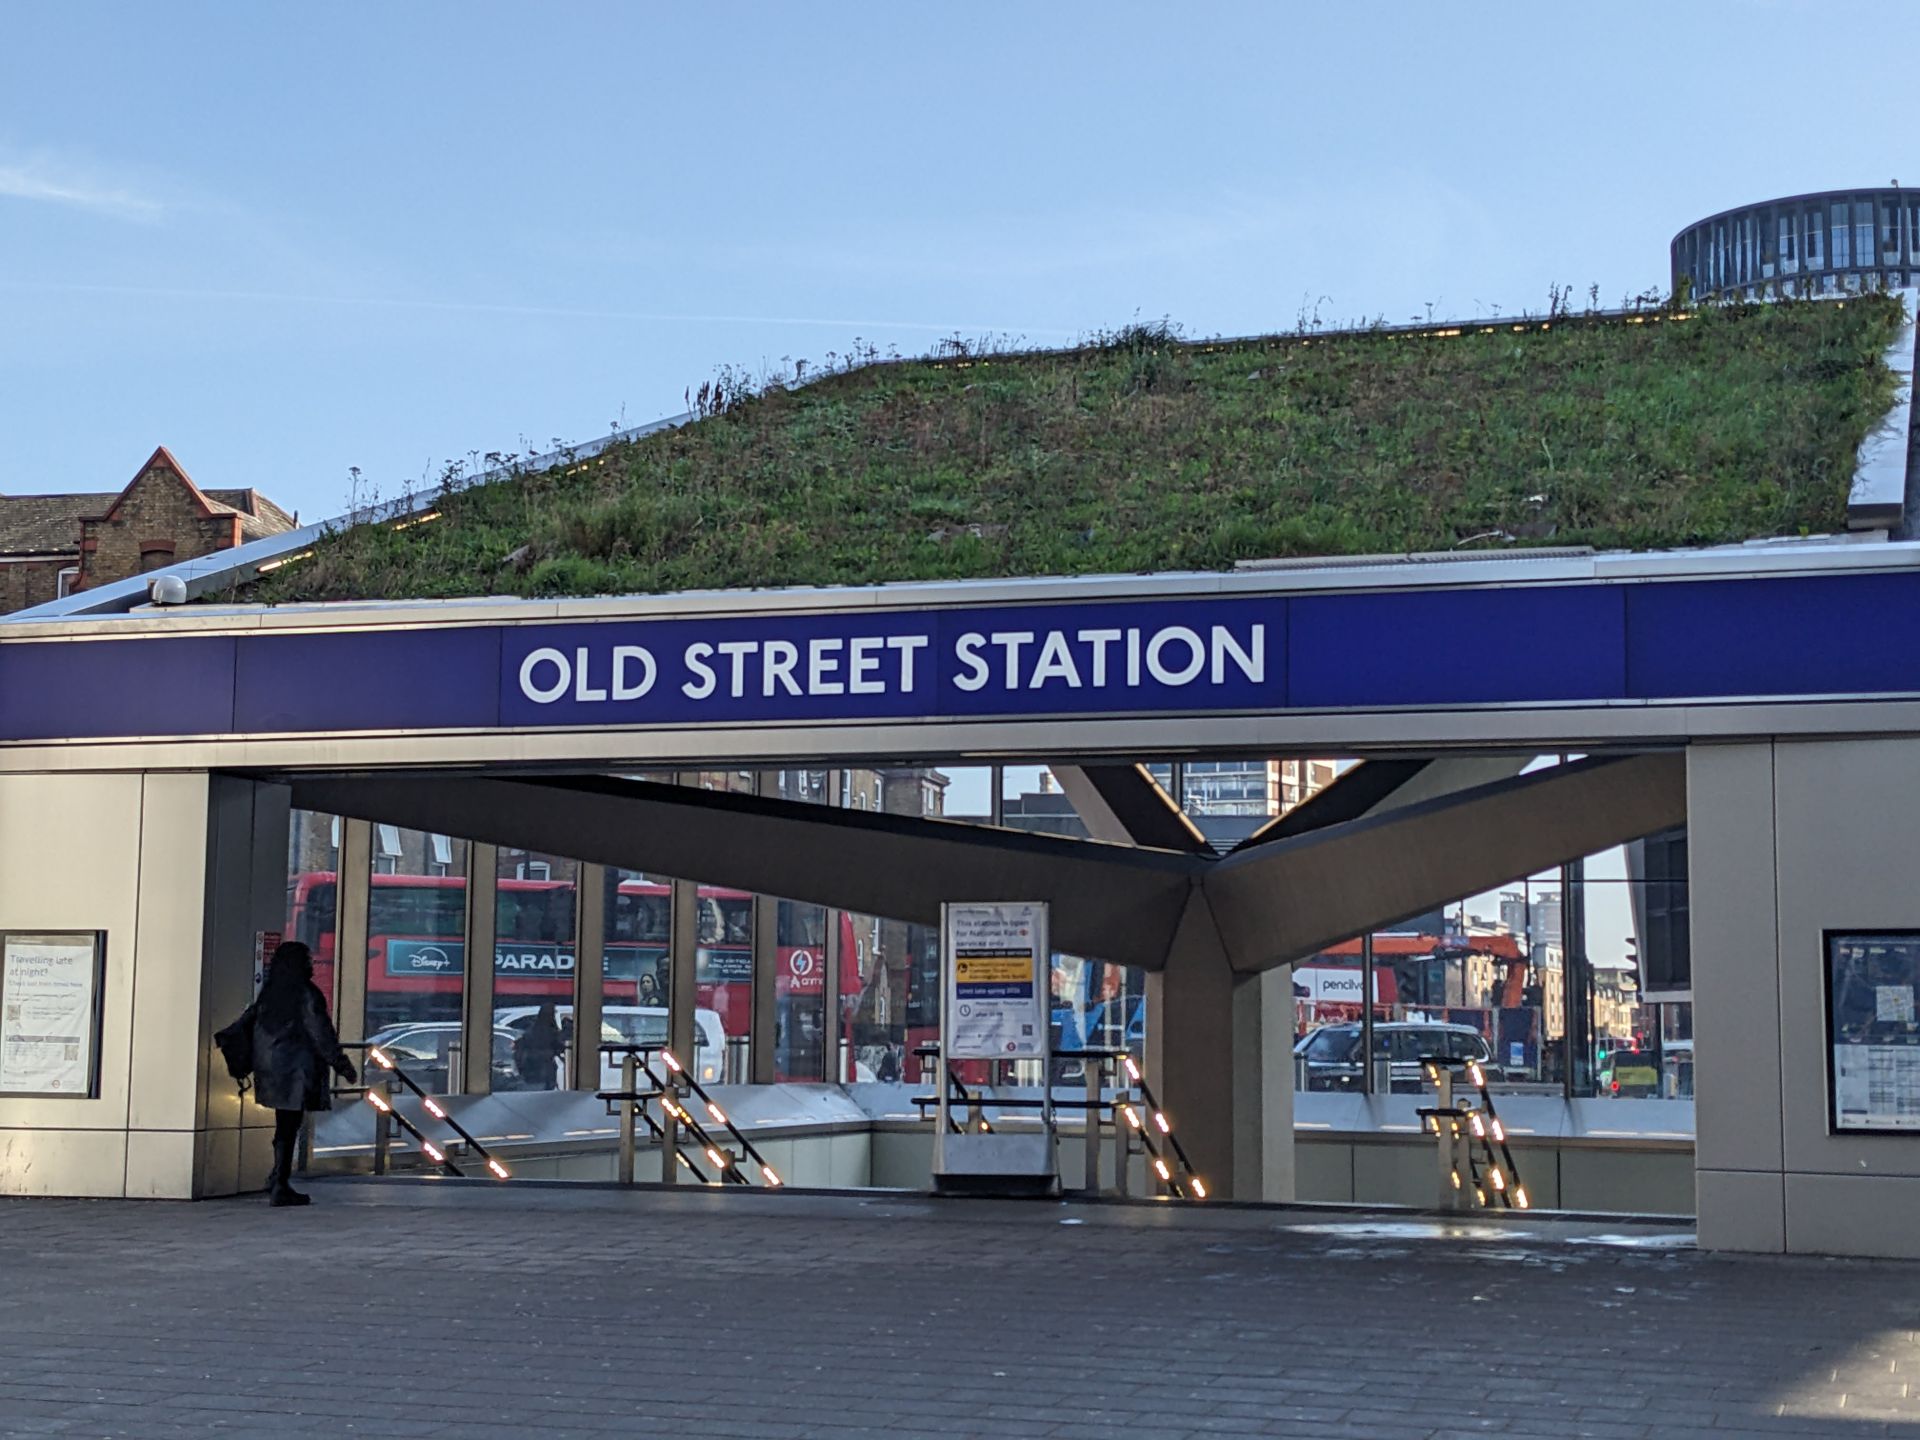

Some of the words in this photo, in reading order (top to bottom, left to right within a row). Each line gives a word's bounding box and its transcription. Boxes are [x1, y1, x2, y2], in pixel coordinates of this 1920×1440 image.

[519, 646, 658, 704] OLD
[681, 635, 930, 700] STREET
[953, 624, 1265, 692] STATION
[10, 954, 54, 967] Travelling
[56, 956, 73, 966] late
[408, 954, 451, 970] Disney+
